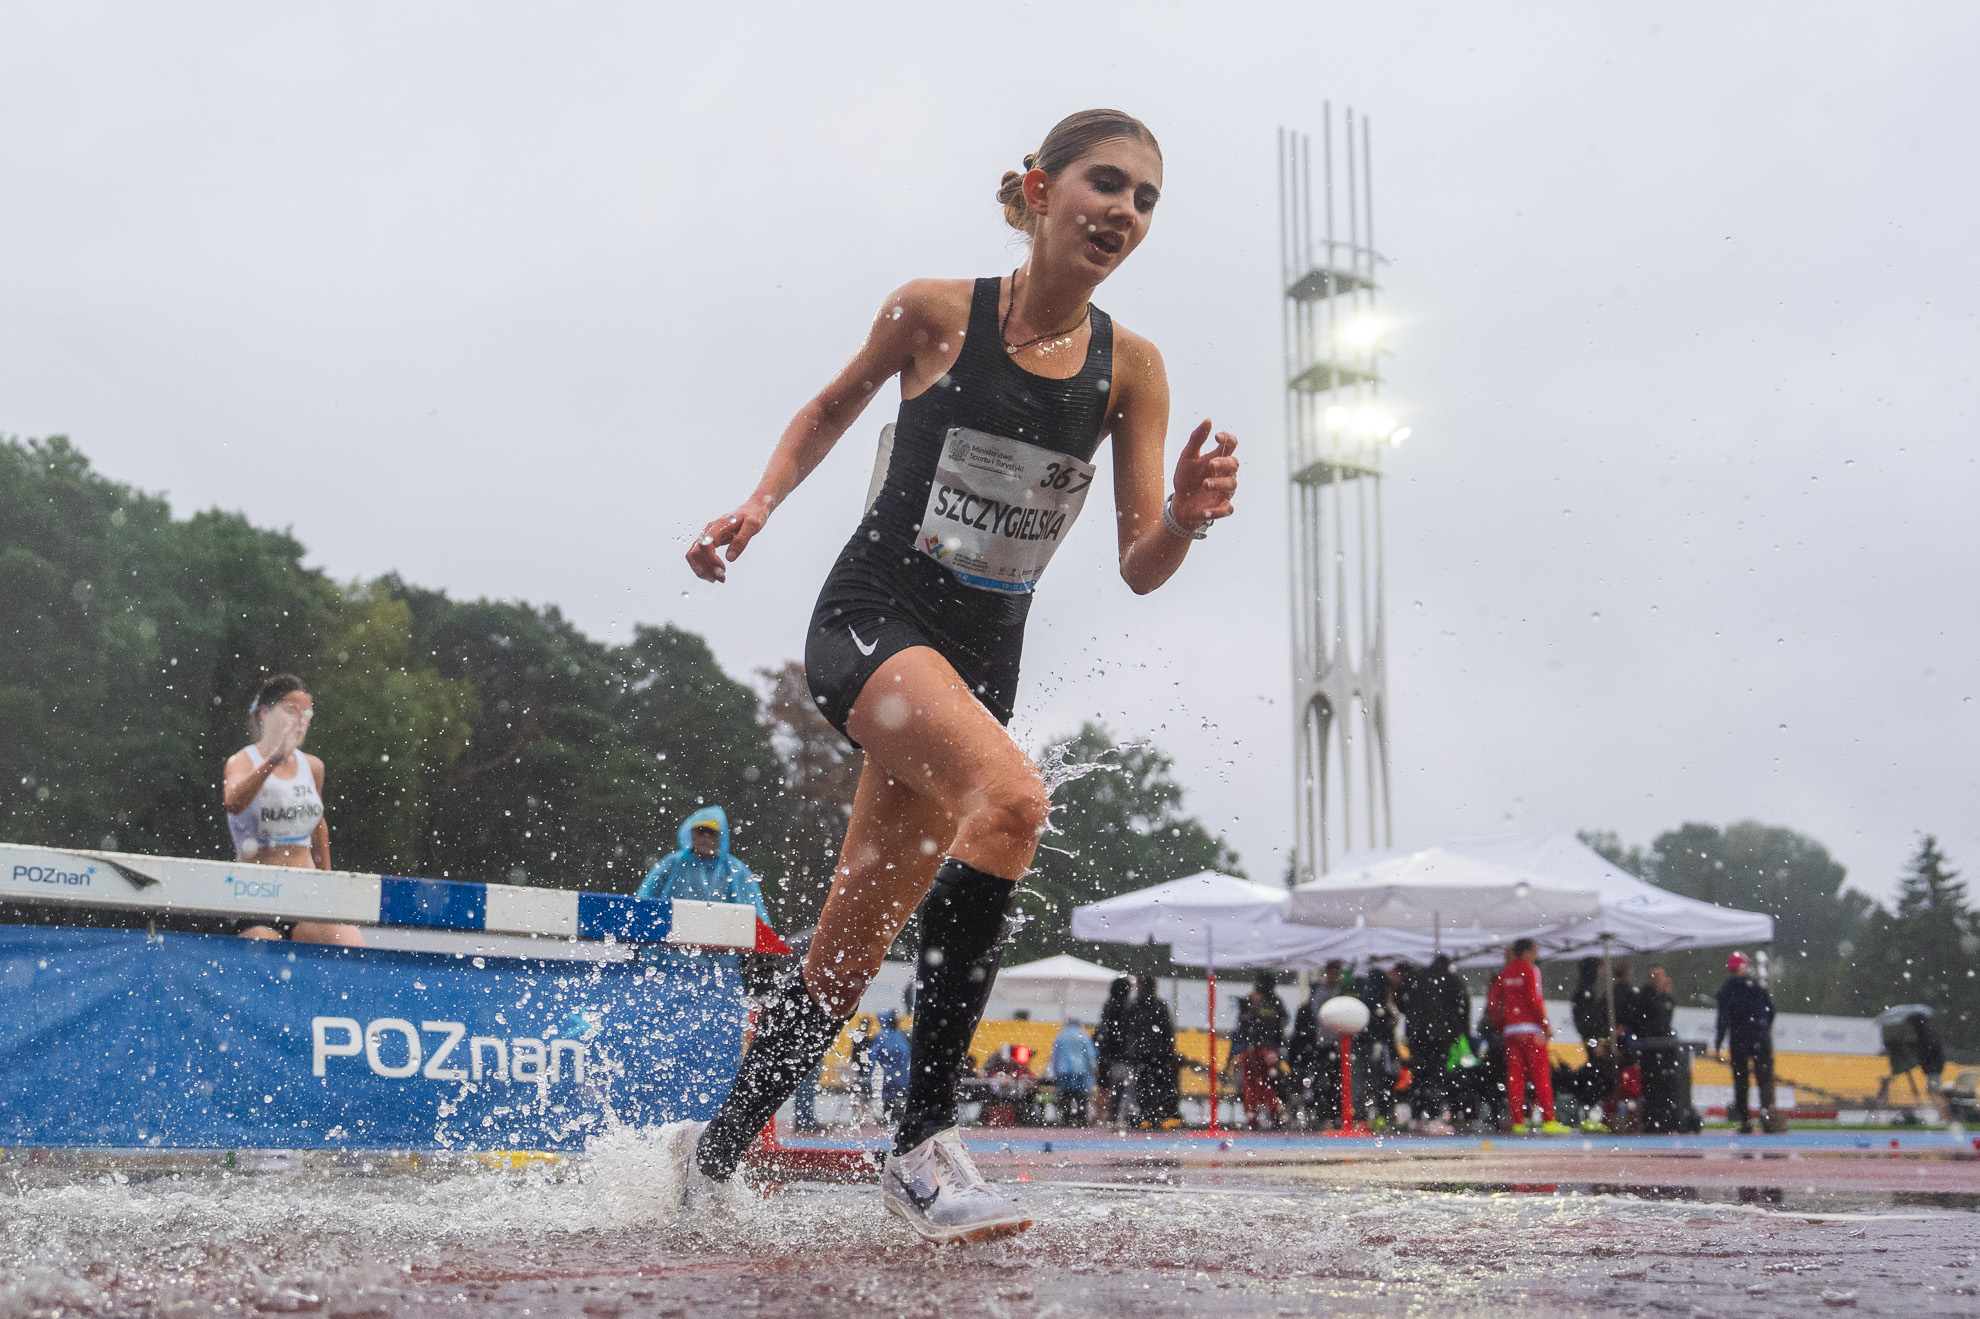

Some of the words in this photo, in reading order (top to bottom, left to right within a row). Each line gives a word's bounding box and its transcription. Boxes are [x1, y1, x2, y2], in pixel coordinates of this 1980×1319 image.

[969, 453, 991, 464] Sportu
[995, 459, 1025, 473] Turystyki
[971, 445, 1013, 461] Ministerstwo
[1040, 462, 1093, 494] 367
[934, 485, 1067, 541] SZCZYGIELSKA
[234, 880, 282, 899] posir
